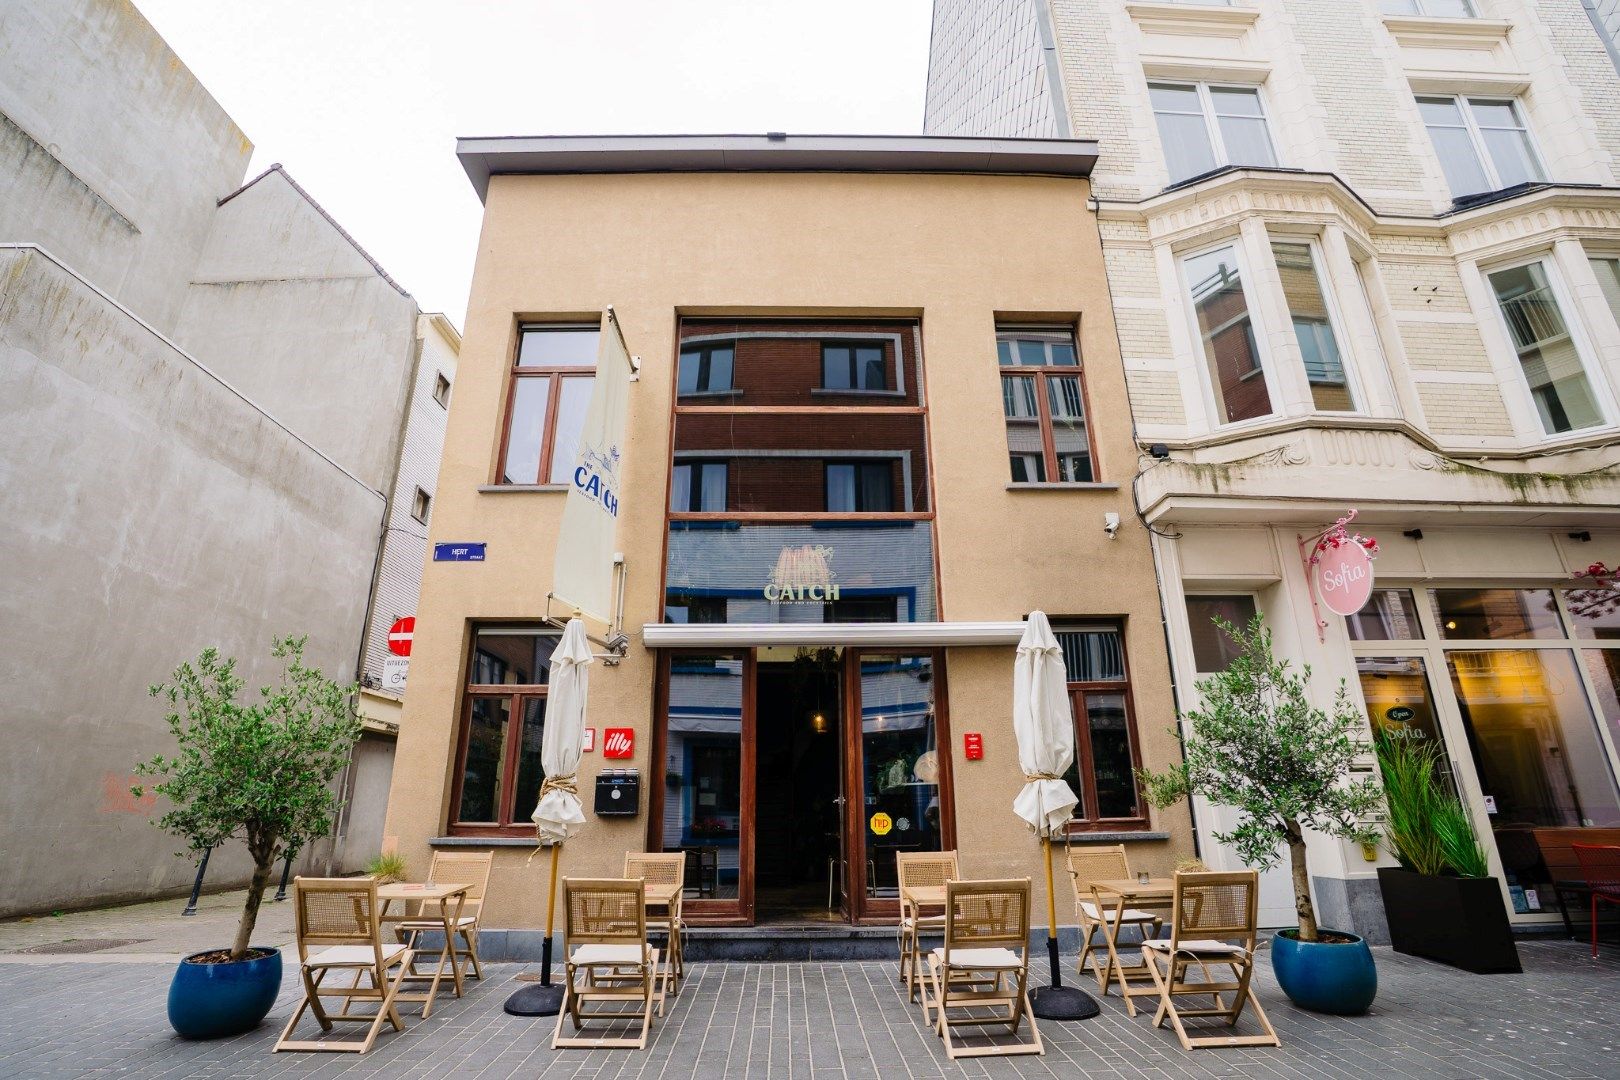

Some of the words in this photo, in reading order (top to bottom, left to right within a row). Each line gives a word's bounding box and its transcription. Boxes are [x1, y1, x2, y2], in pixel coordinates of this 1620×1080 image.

[574, 466, 618, 518] CATCH
[451, 548, 469, 556] HERT
[1323, 561, 1366, 595] Sofia
[763, 583, 840, 601] CATCH
[1392, 710, 1410, 720] Open
[605, 732, 632, 756] illy
[1384, 721, 1428, 746] Sofia
